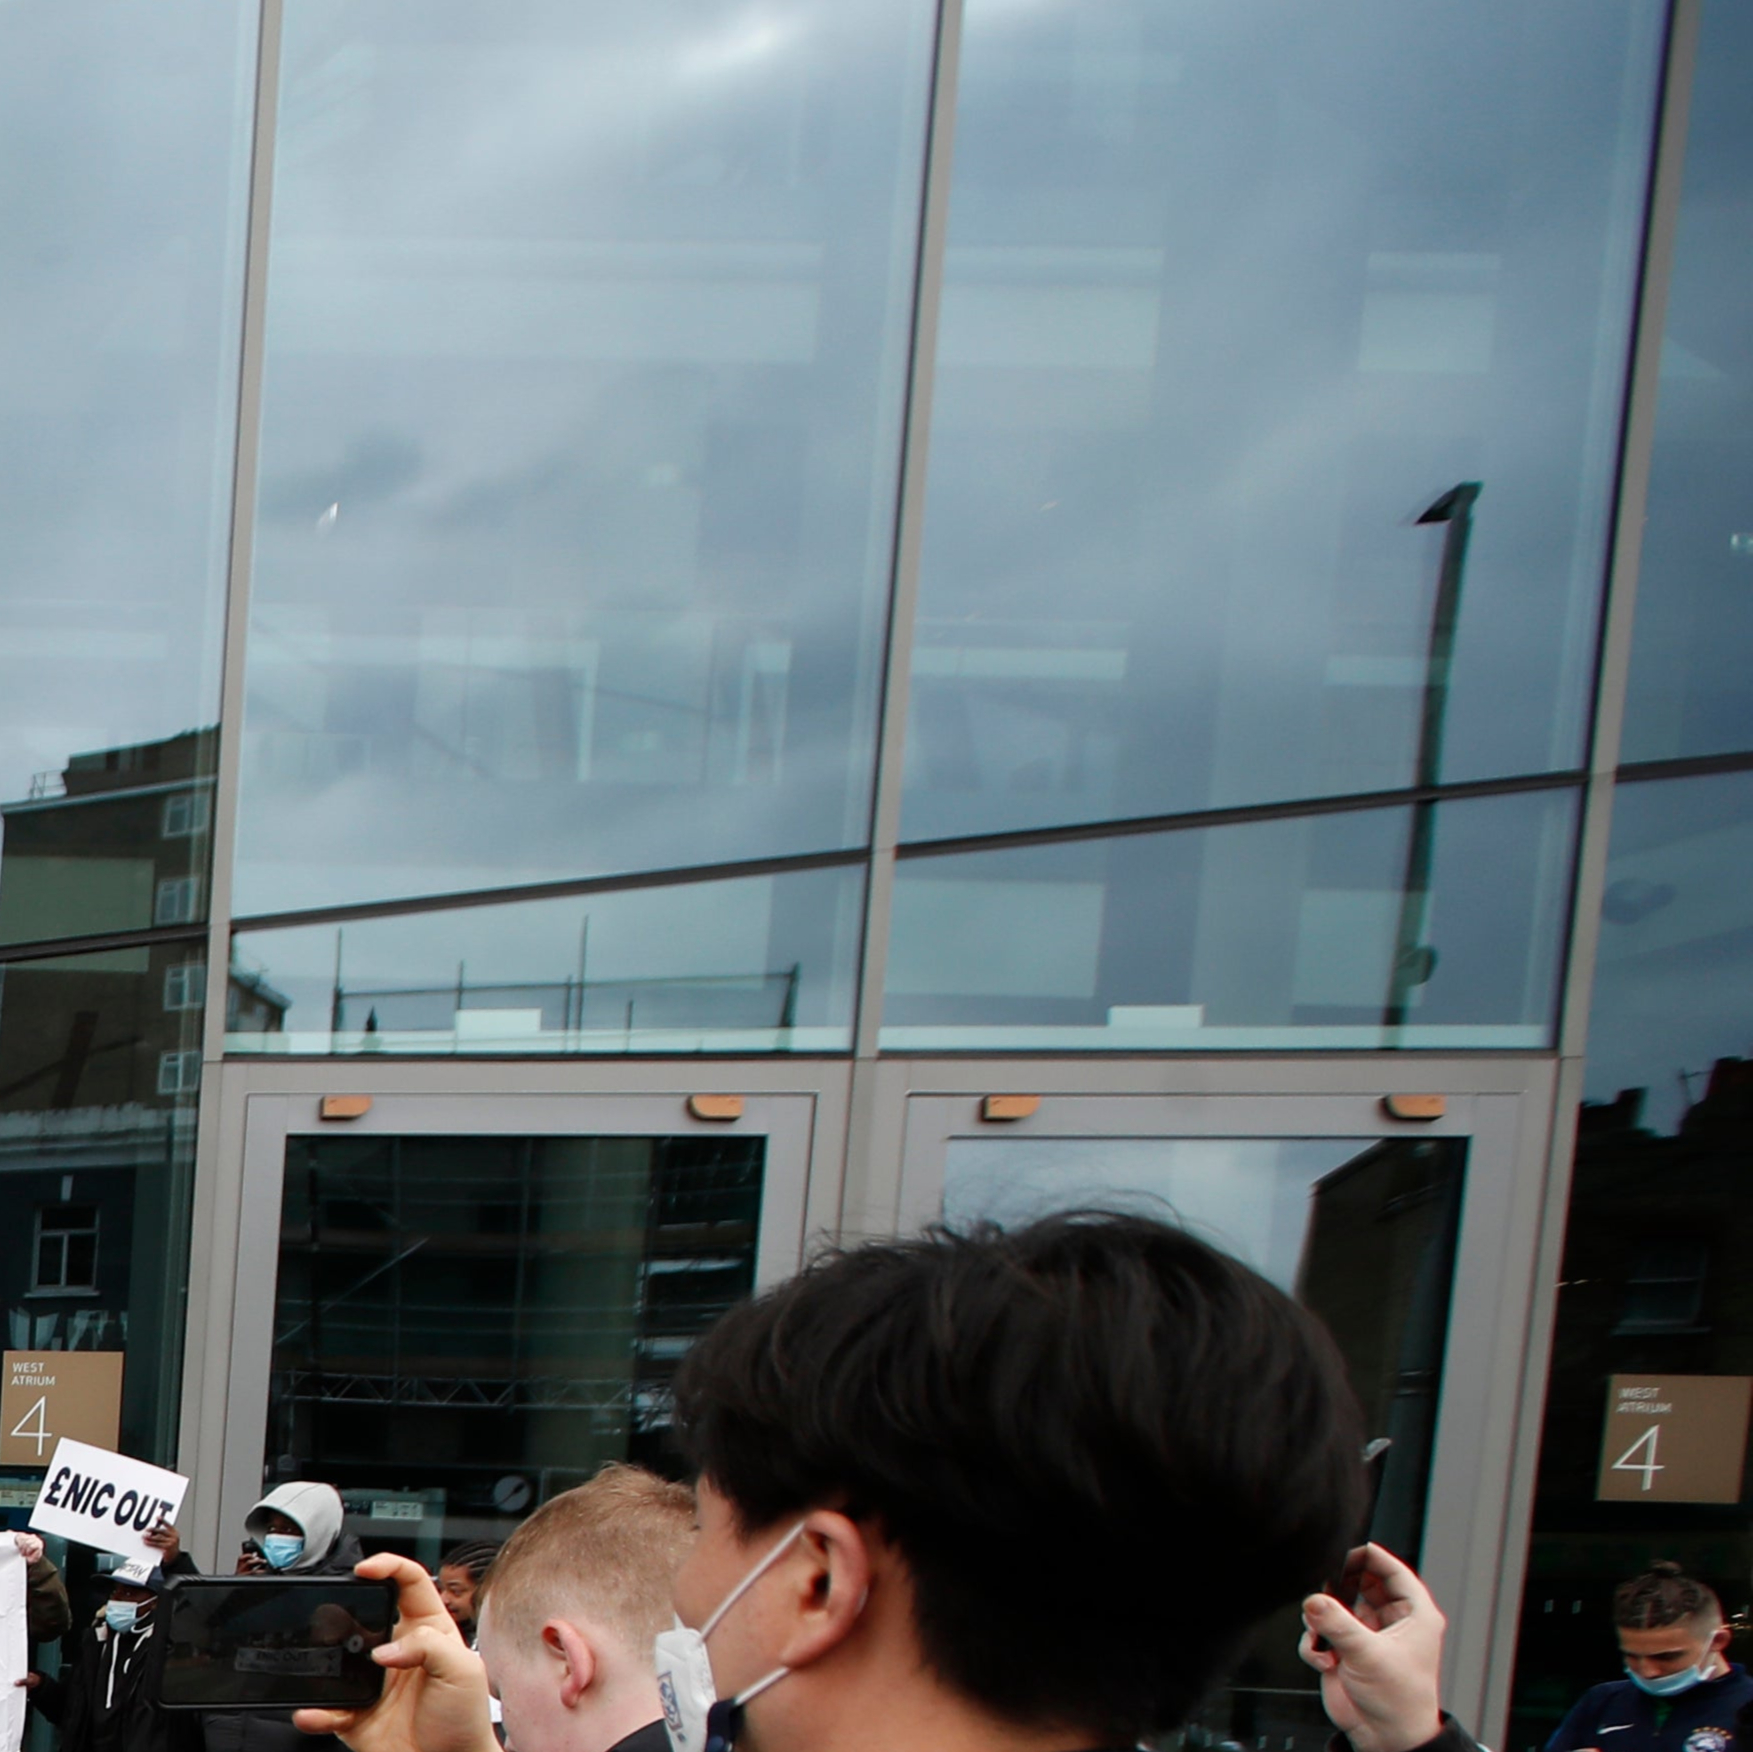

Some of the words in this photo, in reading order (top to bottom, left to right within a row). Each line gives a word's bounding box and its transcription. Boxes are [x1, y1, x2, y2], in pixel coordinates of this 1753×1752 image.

[11, 1375, 56, 1386] ATRIUM
[12, 1362, 45, 1373] WEST
[1618, 1387, 1661, 1399] WEST
[11, 1396, 52, 1456] 4
[1611, 1424, 1665, 1491] 4
[114, 1490, 175, 1533] OUT
